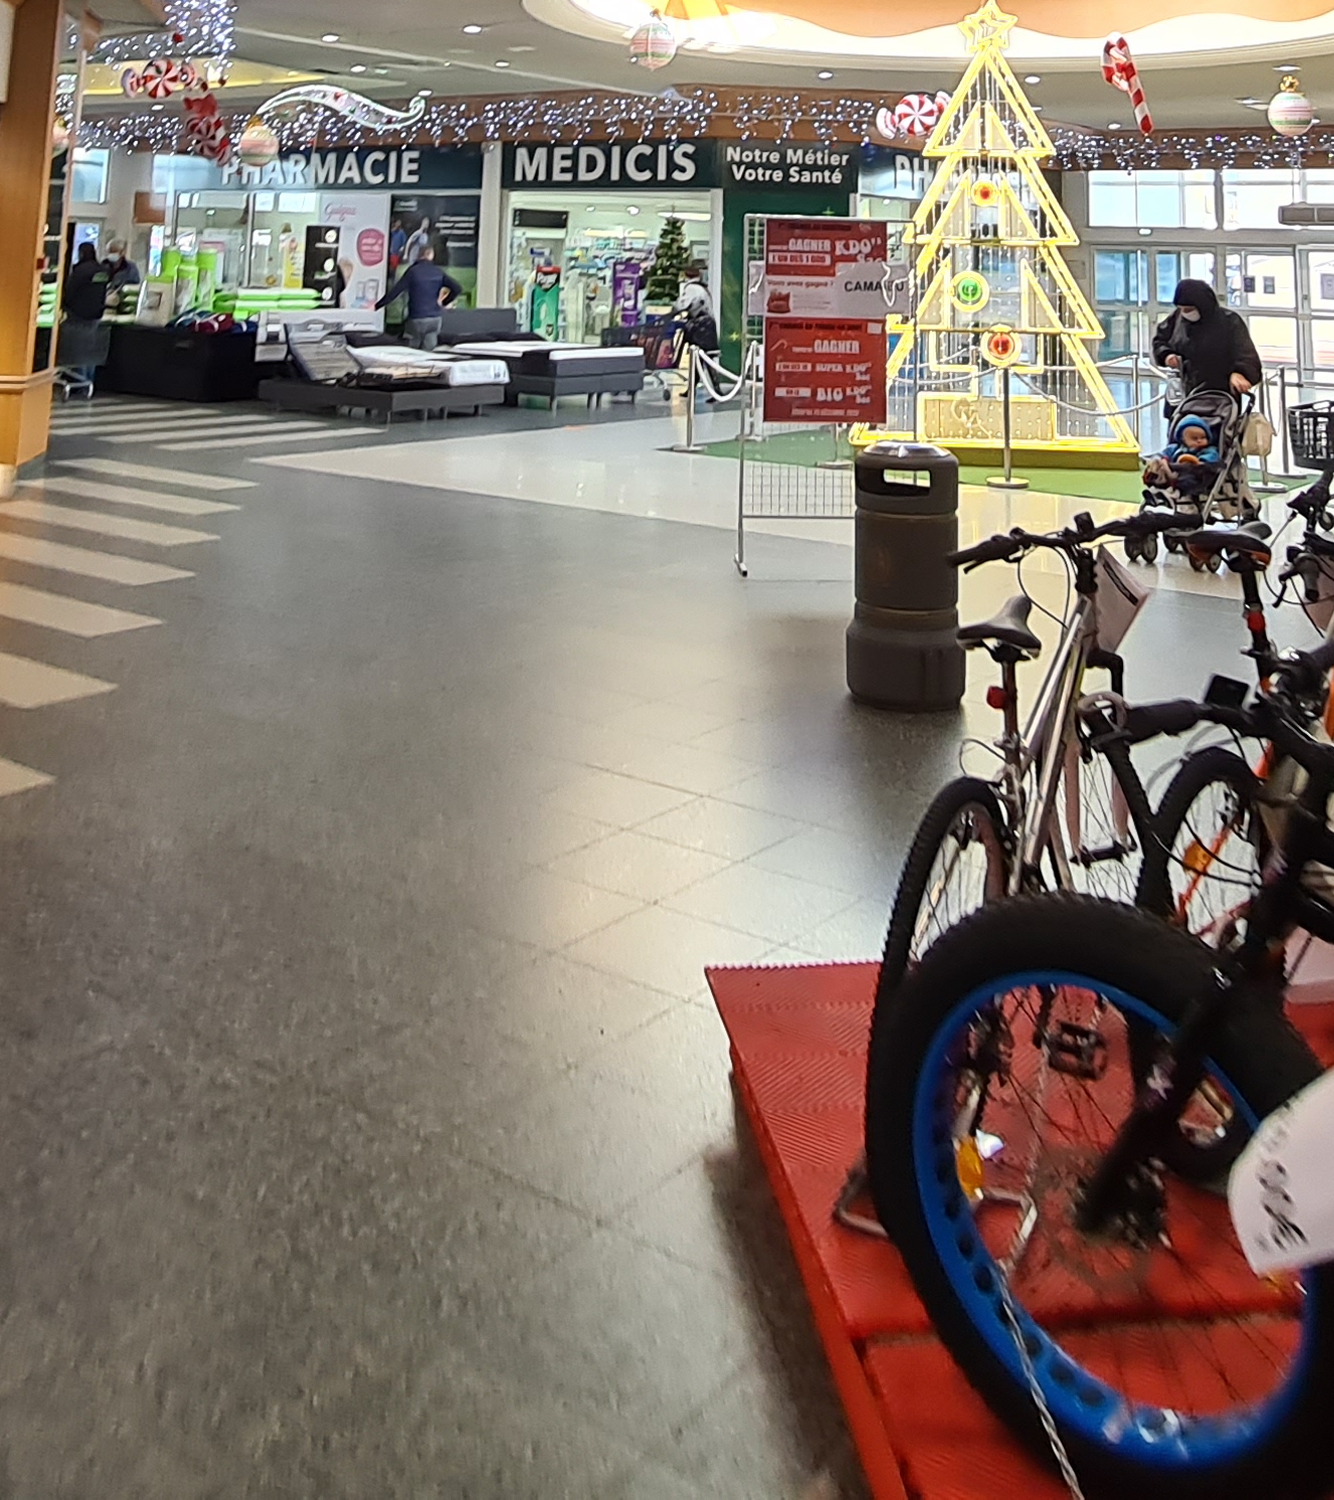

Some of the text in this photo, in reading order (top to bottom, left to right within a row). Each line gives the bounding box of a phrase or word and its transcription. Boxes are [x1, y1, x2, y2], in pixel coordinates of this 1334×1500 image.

[514, 144, 697, 182] MEDICIS
[726, 146, 850, 167] Notre Métier
[732, 163, 843, 185] Votre Santé
